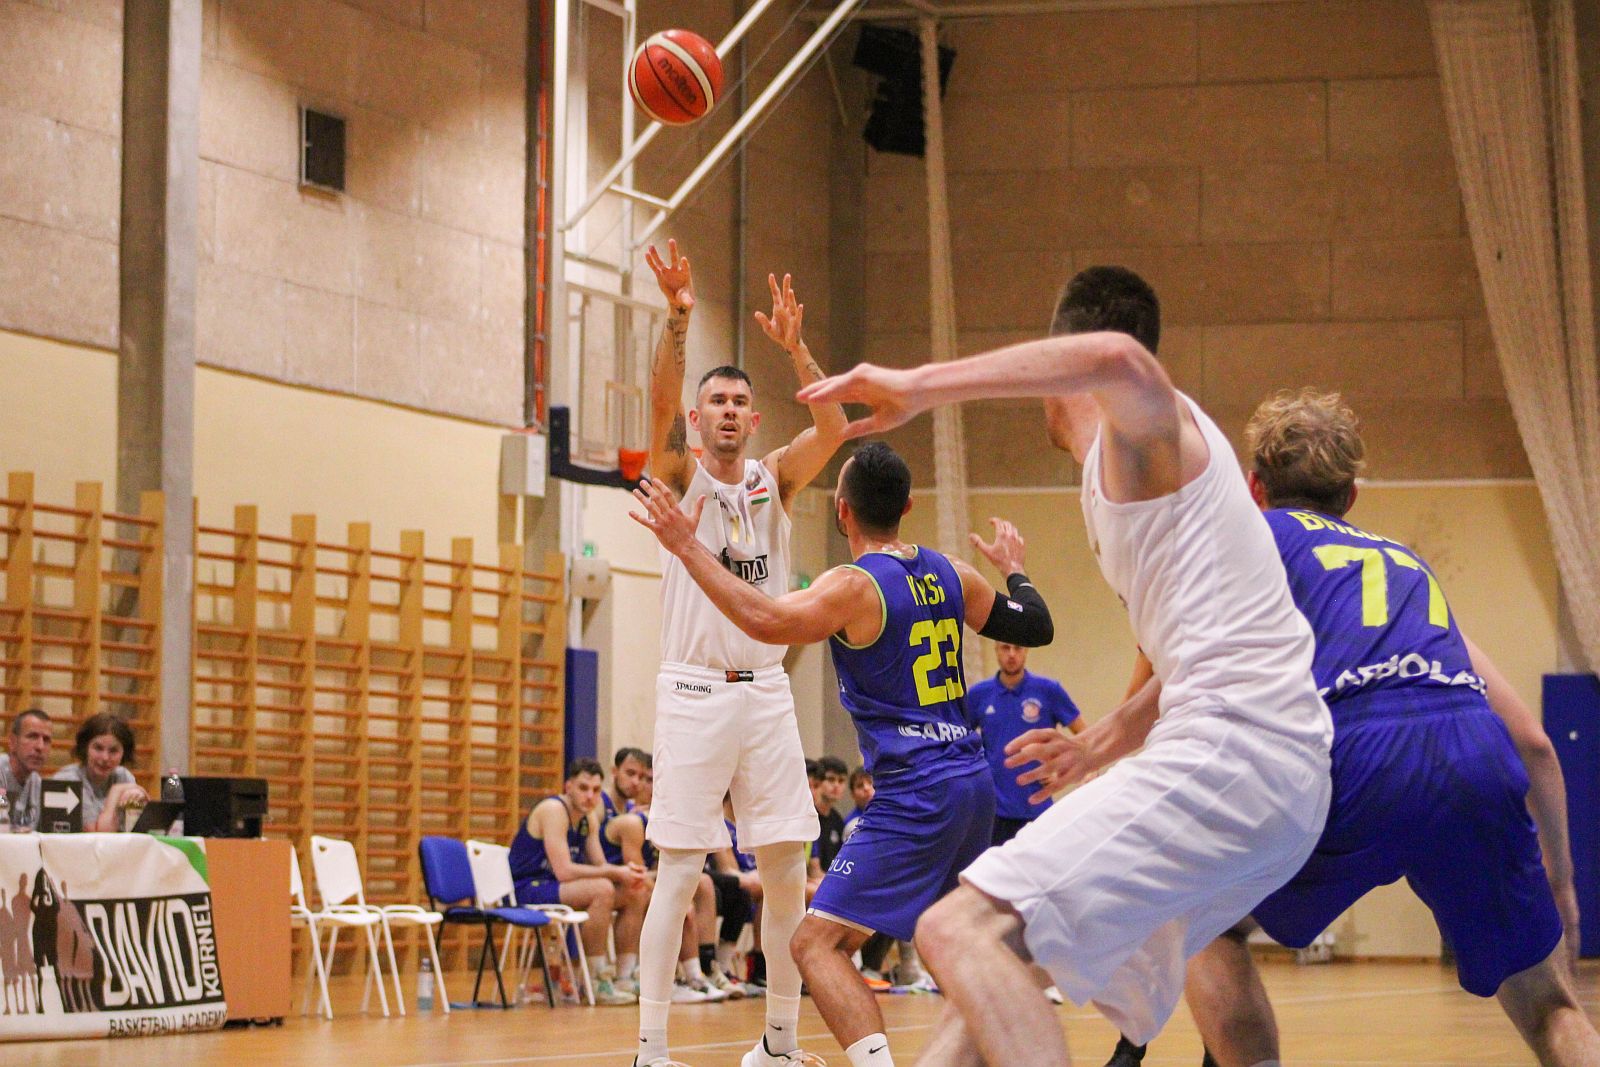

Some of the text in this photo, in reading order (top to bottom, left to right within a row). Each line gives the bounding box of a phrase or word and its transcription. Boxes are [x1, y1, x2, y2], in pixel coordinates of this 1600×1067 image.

[1312, 544, 1449, 629] 77
[675, 681, 712, 694] SPALDING
[909, 618, 963, 706] 23
[86, 898, 203, 1006] DAVID
[192, 896, 222, 998] KORNEL
[109, 1010, 228, 1037] BASKETBALL ACADEMY
